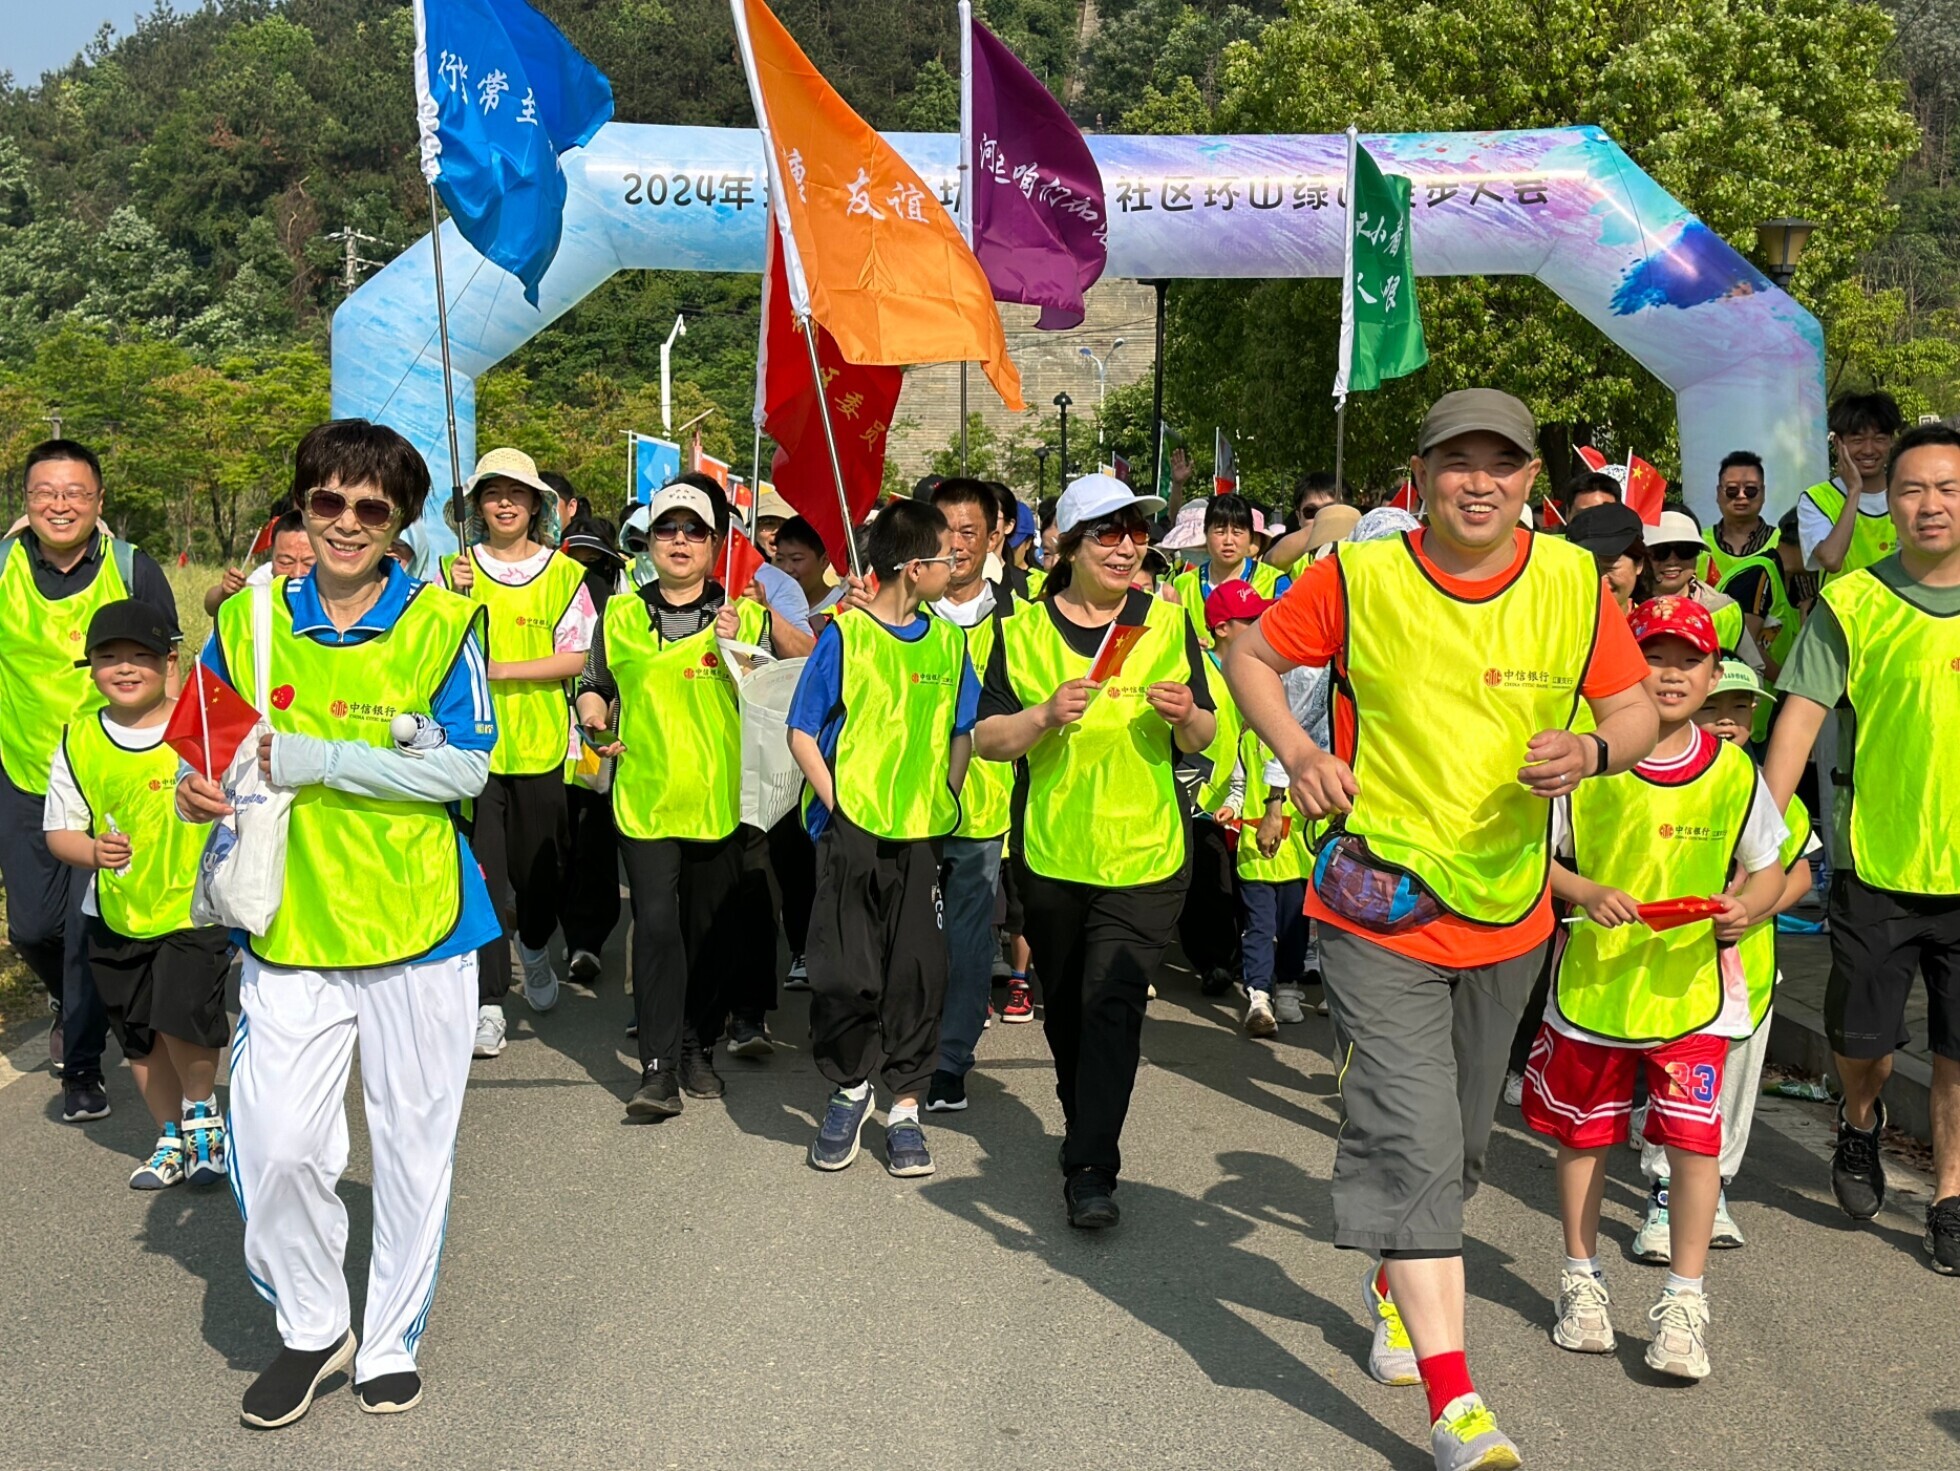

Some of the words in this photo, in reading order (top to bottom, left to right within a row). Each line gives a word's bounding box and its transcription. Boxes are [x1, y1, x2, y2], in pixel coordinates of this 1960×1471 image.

[1504, 669, 1549, 683] 中信银行
[350, 702, 397, 718] 中信银行
[1664, 1061, 1717, 1103] 23
